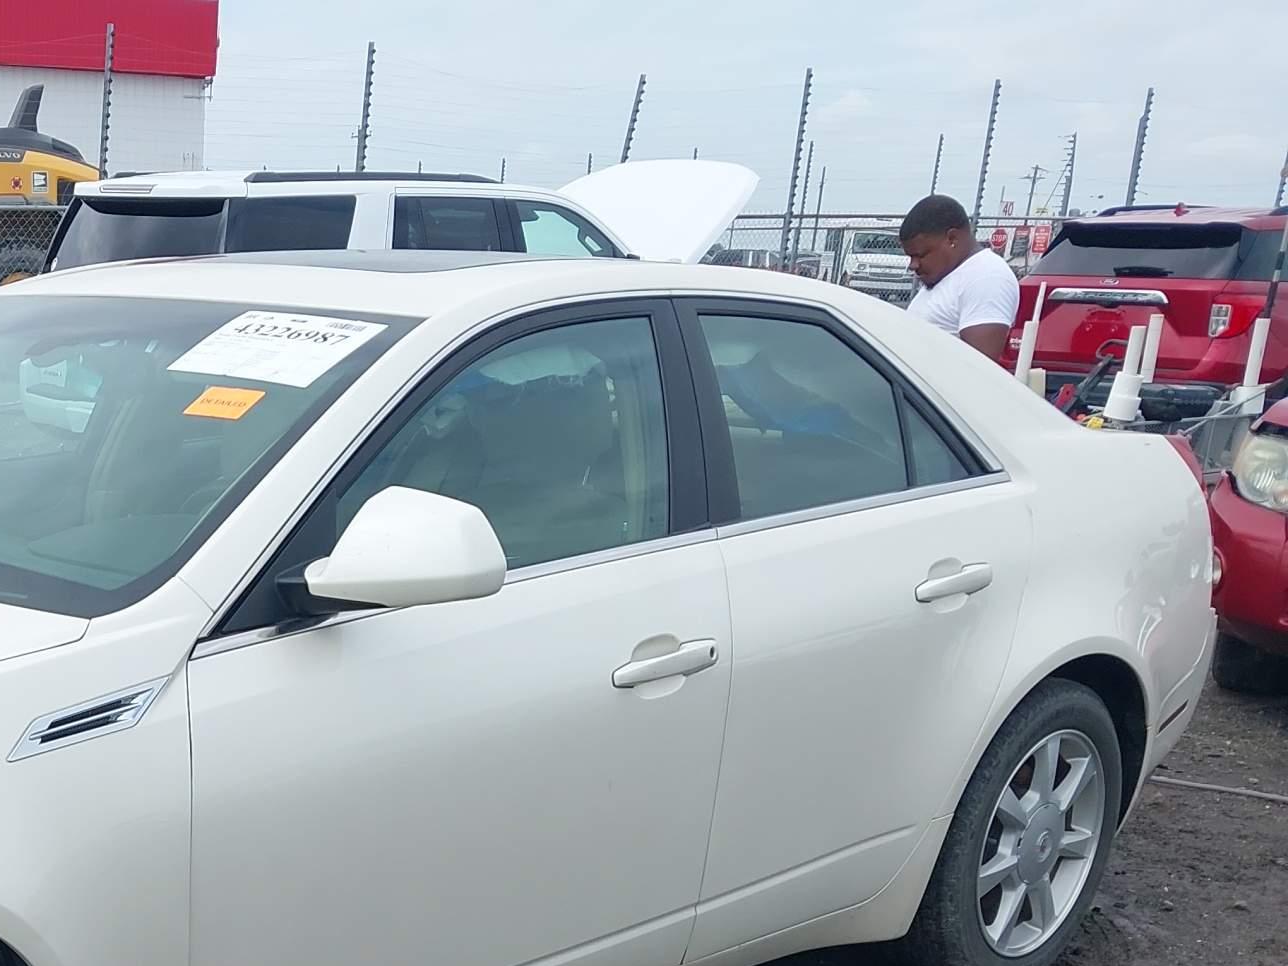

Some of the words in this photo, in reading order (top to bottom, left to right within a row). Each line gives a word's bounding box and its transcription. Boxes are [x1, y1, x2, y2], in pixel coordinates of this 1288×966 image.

[1003, 202, 1014, 216] 40
[992, 234, 1007, 242] STOP
[234, 322, 351, 346] 43226987
[200, 398, 247, 407] DETAILED
